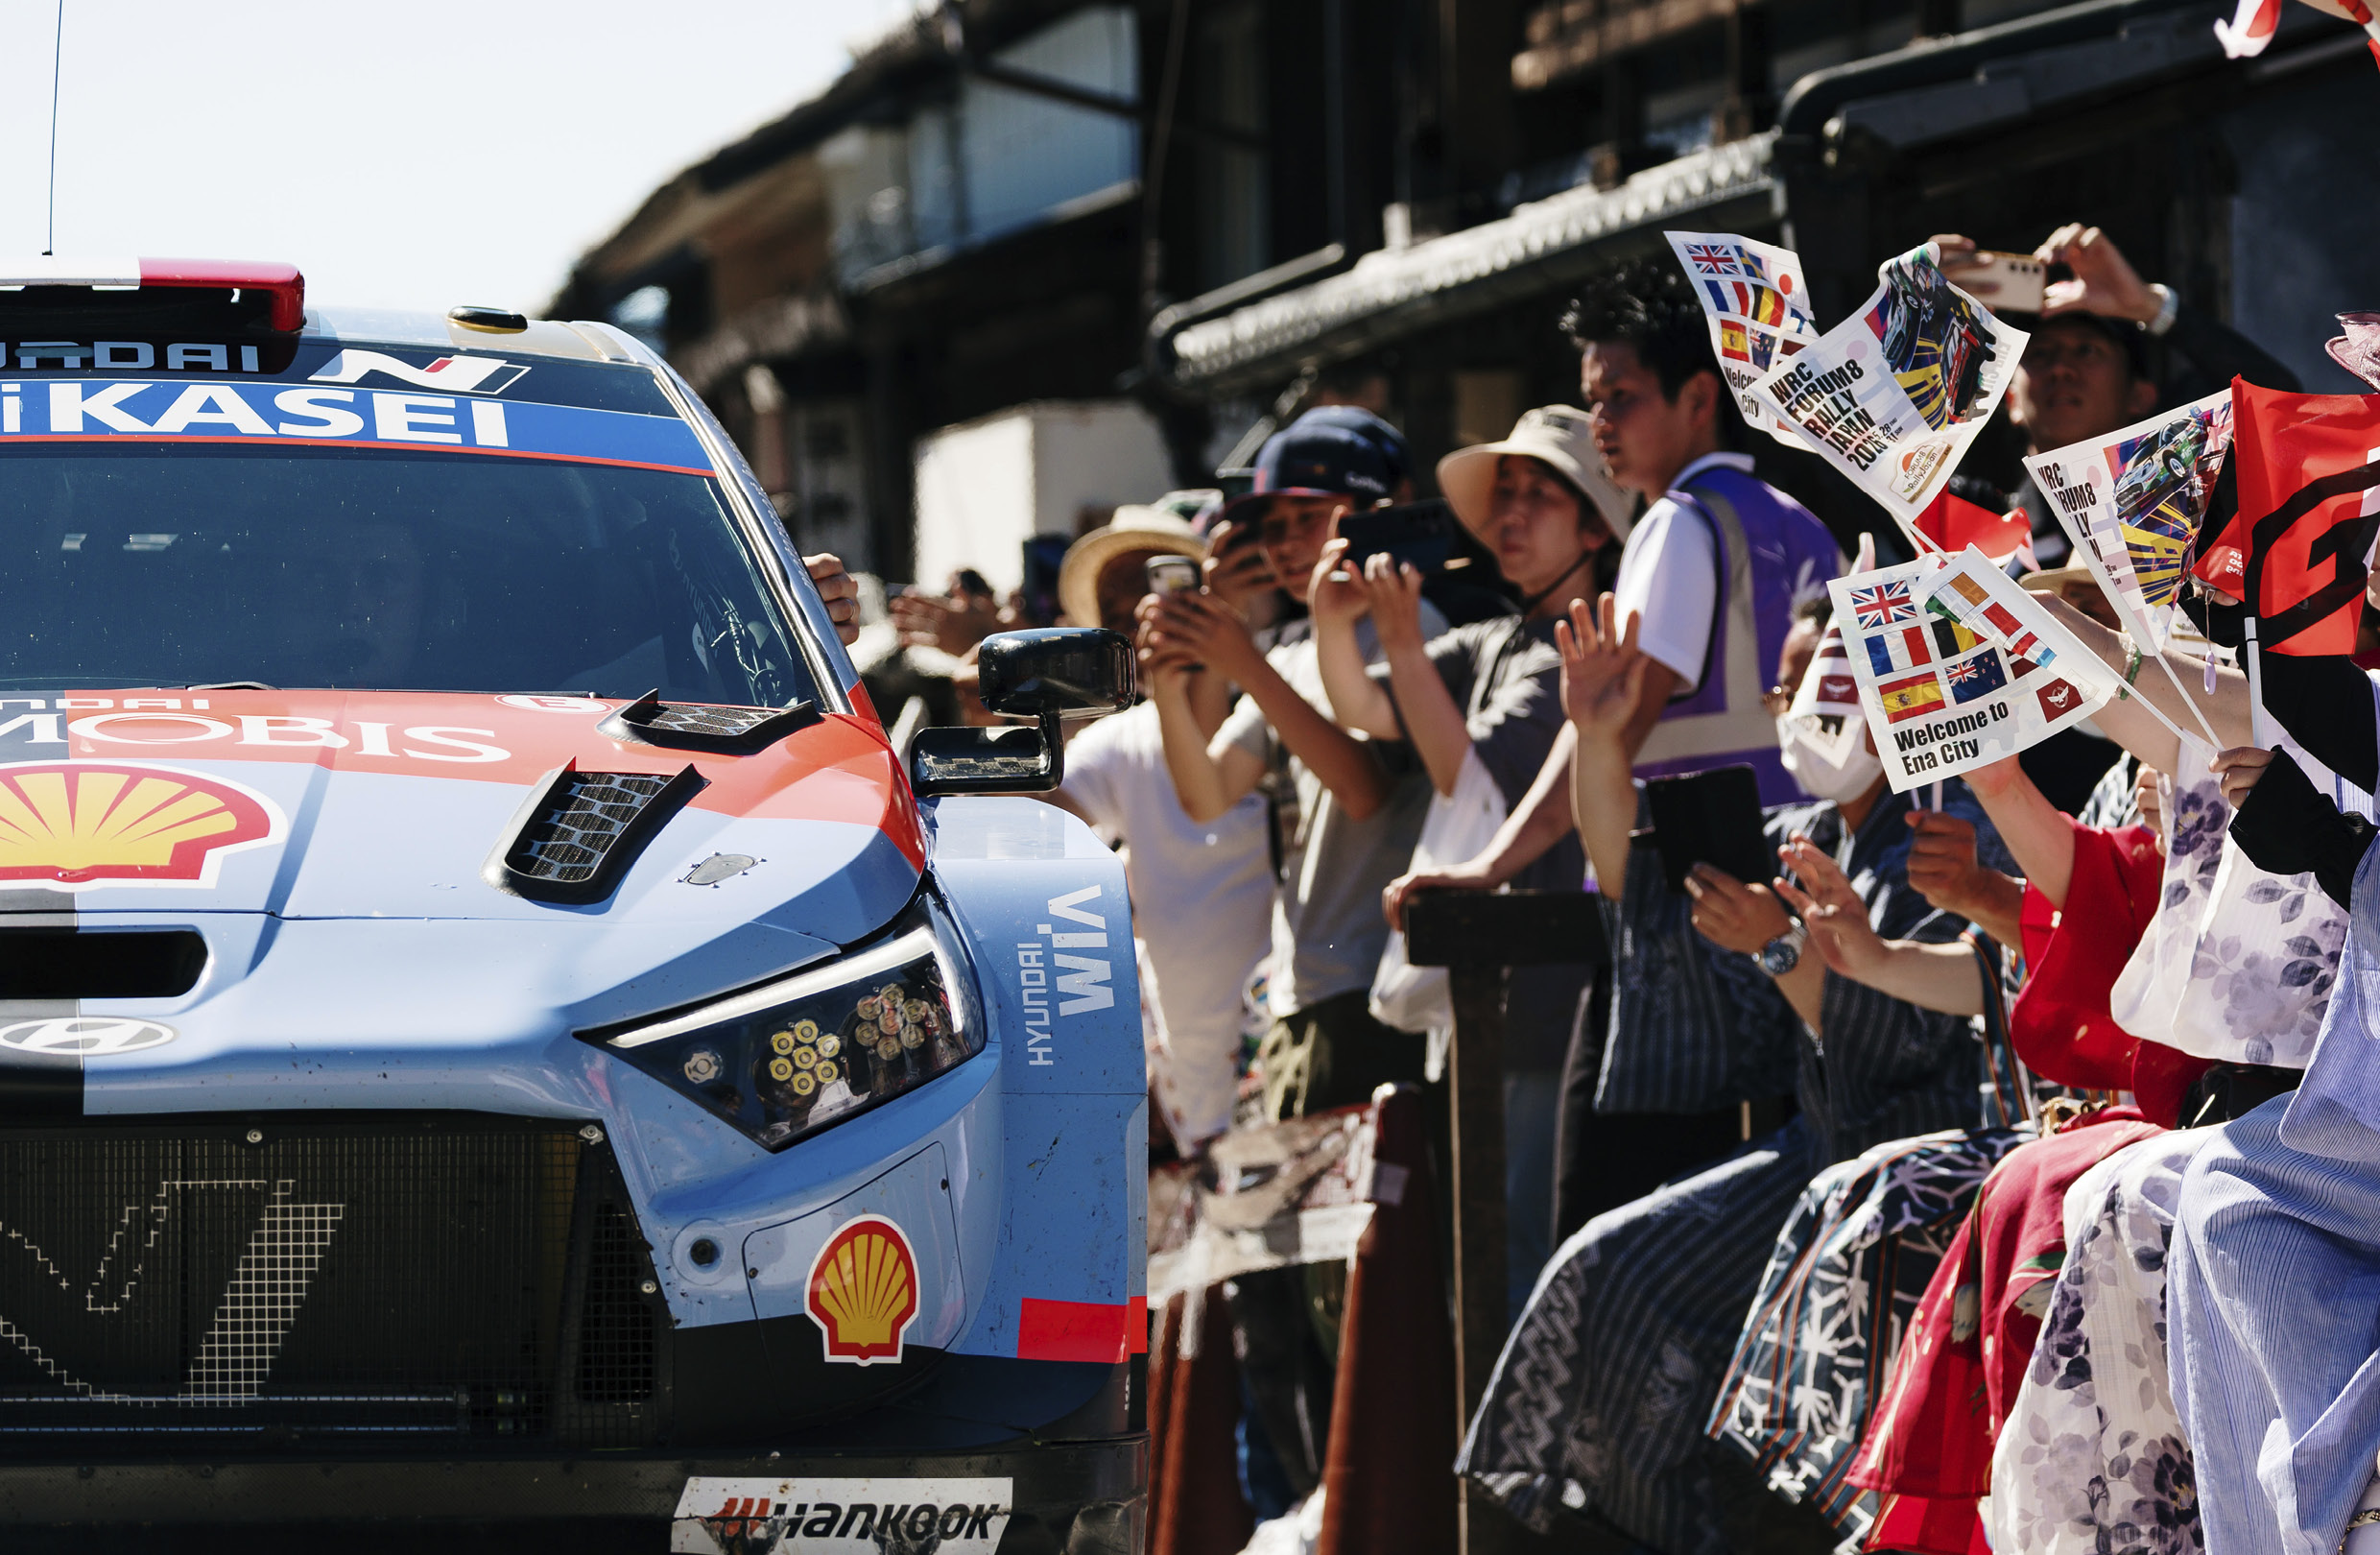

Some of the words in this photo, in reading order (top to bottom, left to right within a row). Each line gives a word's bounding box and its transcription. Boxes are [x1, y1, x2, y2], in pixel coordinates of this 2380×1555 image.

[0, 341, 259, 372] NDAI
[1769, 362, 1813, 404] WRC
[1785, 359, 1864, 422] FORUM8
[1742, 394, 1759, 418] City
[1803, 389, 1859, 439] RALLY
[1824, 408, 1876, 456] JAPAN
[1846, 435, 1889, 471] 2026
[1904, 450, 1926, 479] FORUM8
[1893, 710, 1987, 753] Welcome
[1988, 702, 2010, 722] to
[1901, 752, 1939, 776] Ena
[1940, 738, 1979, 764] City
[1017, 943, 1054, 1065] HYUNDAI
